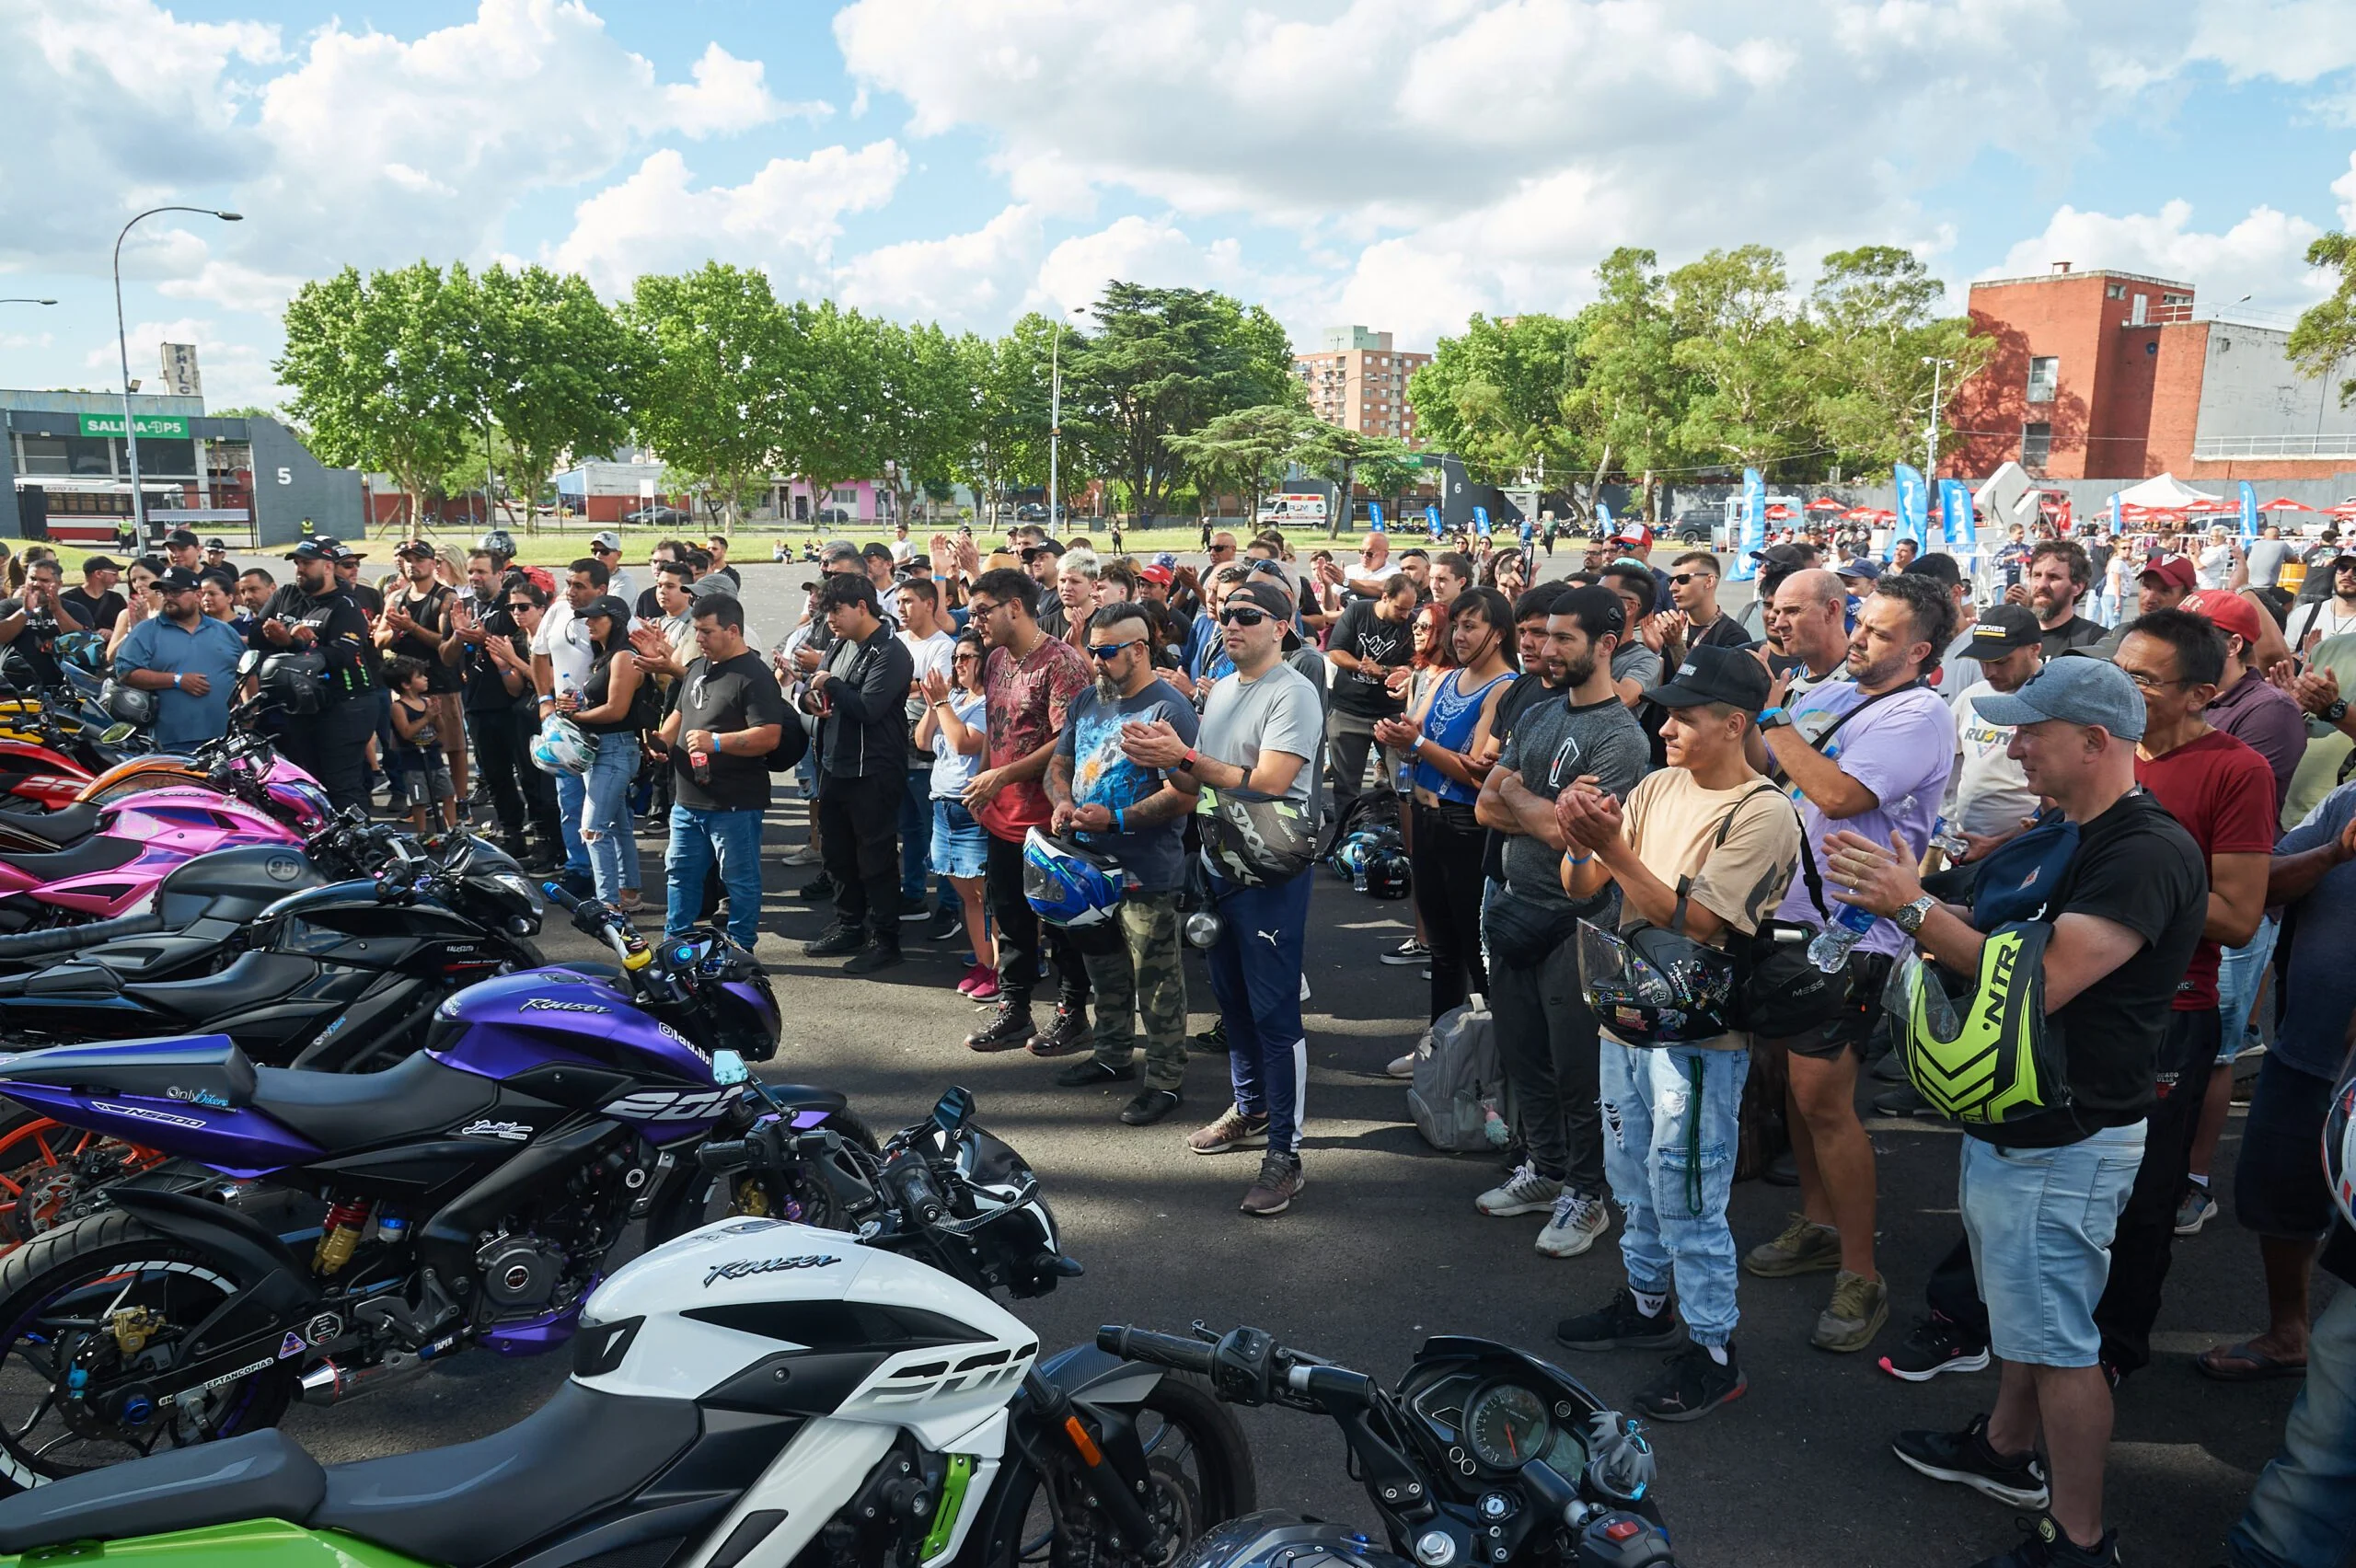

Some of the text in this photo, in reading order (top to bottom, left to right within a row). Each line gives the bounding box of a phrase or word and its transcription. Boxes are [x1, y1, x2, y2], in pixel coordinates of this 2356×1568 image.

[163, 421, 181, 433] P5
[278, 467, 292, 485] 5
[1454, 482, 1461, 494] 6
[271, 860, 294, 873] 95
[1985, 944, 2018, 1027] NTR
[518, 997, 614, 1014] Rouser
[673, 1030, 713, 1068] lau.lis
[128, 1107, 204, 1127] NS200
[704, 1254, 842, 1288] Rouser
[433, 1336, 454, 1353] TAPER
